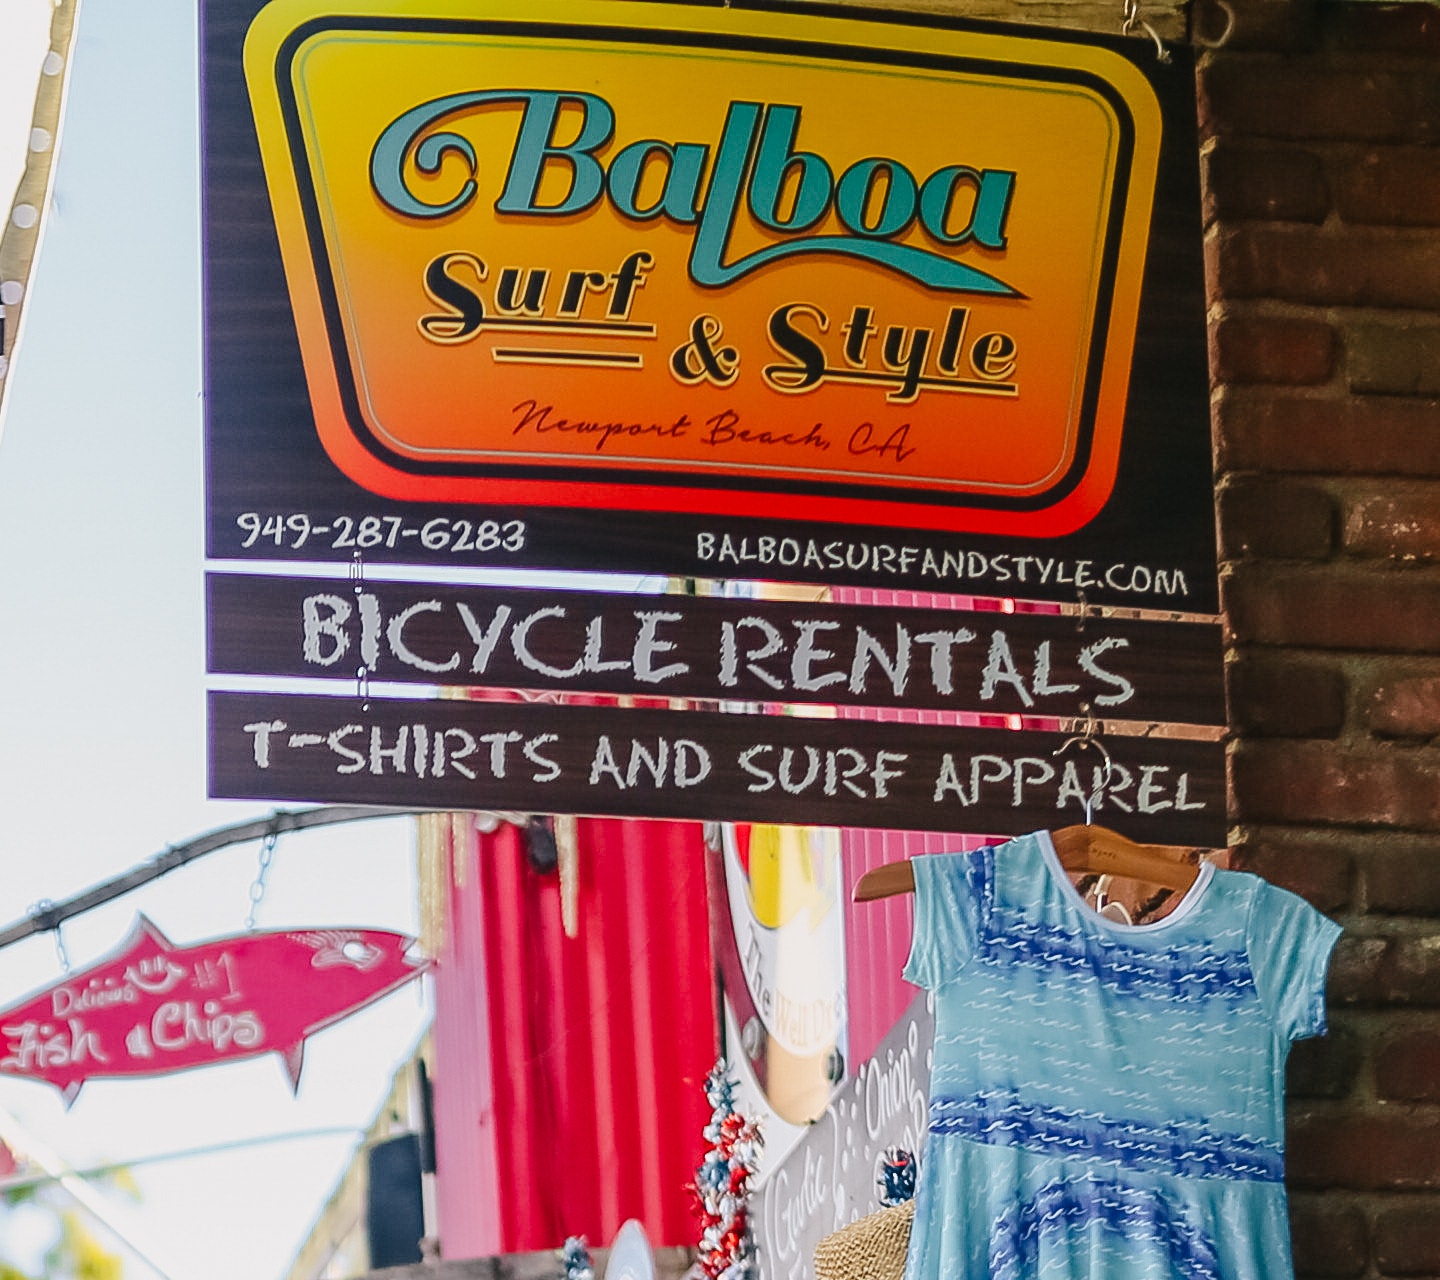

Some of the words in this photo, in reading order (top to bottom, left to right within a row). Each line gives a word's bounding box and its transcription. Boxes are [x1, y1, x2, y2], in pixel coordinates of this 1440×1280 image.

[369, 88, 1031, 300] Balboa
[418, 250, 656, 343] Surf
[670, 314, 740, 388] &
[763, 303, 1019, 402] Style
[513, 400, 692, 451] Newport
[700, 409, 831, 451] Beach,
[848, 423, 917, 463] CA
[237, 512, 526, 552] 949-287-6283
[696, 531, 1189, 597] BALBOASURFANDSTYLE.COM
[302, 592, 690, 683] BICYCLE
[717, 616, 1135, 708] RENTALS
[243, 718, 563, 784] T-SHIRTS
[588, 734, 713, 790] AND
[737, 744, 910, 799] SURF
[933, 753, 1206, 816] APPAREL
[745, 920, 771, 1017] The
[0, 1017, 108, 1069] Fish
[151, 1001, 264, 1050] Chips
